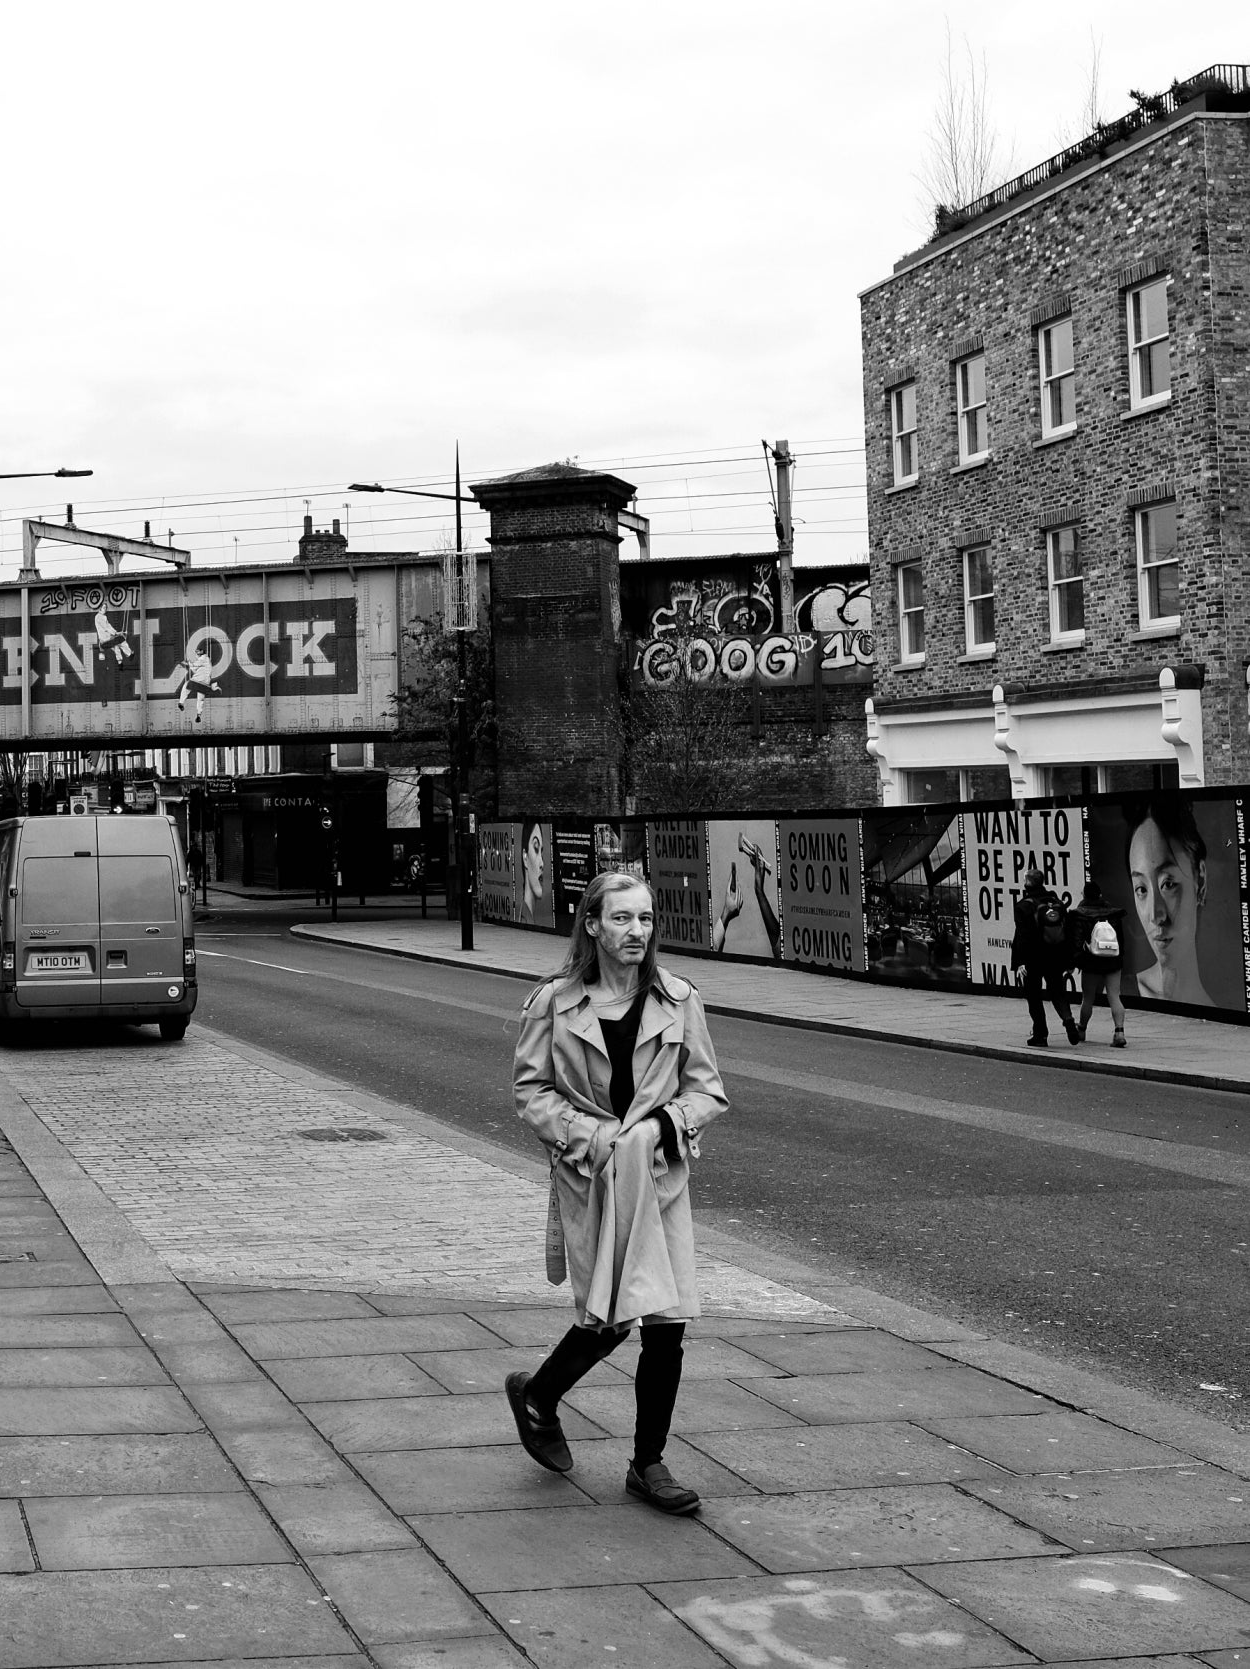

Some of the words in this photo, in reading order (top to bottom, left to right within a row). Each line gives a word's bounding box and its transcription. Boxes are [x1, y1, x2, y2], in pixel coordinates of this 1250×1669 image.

[134, 617, 337, 698] LOCK
[483, 831, 510, 850] COMING
[974, 811, 1033, 845] WANT
[1039, 809, 1069, 847] TO
[1236, 809, 1246, 844] WHARF
[654, 833, 699, 860] CAMDEN
[788, 831, 848, 863] COMING
[1083, 831, 1091, 868] CAMDEN
[789, 863, 850, 896] SOON
[978, 848, 1004, 883] BE
[1013, 850, 1071, 887] PART
[1238, 848, 1247, 888] HAWLEY
[657, 887, 686, 914] ONLY
[689, 890, 703, 916] IN
[979, 885, 1004, 921] OF
[658, 914, 703, 944] CAMDEN
[1241, 902, 1250, 944] CAMDEN
[792, 926, 853, 962] COMING
[37, 956, 59, 968] MT10
[61, 956, 82, 968] OTM
